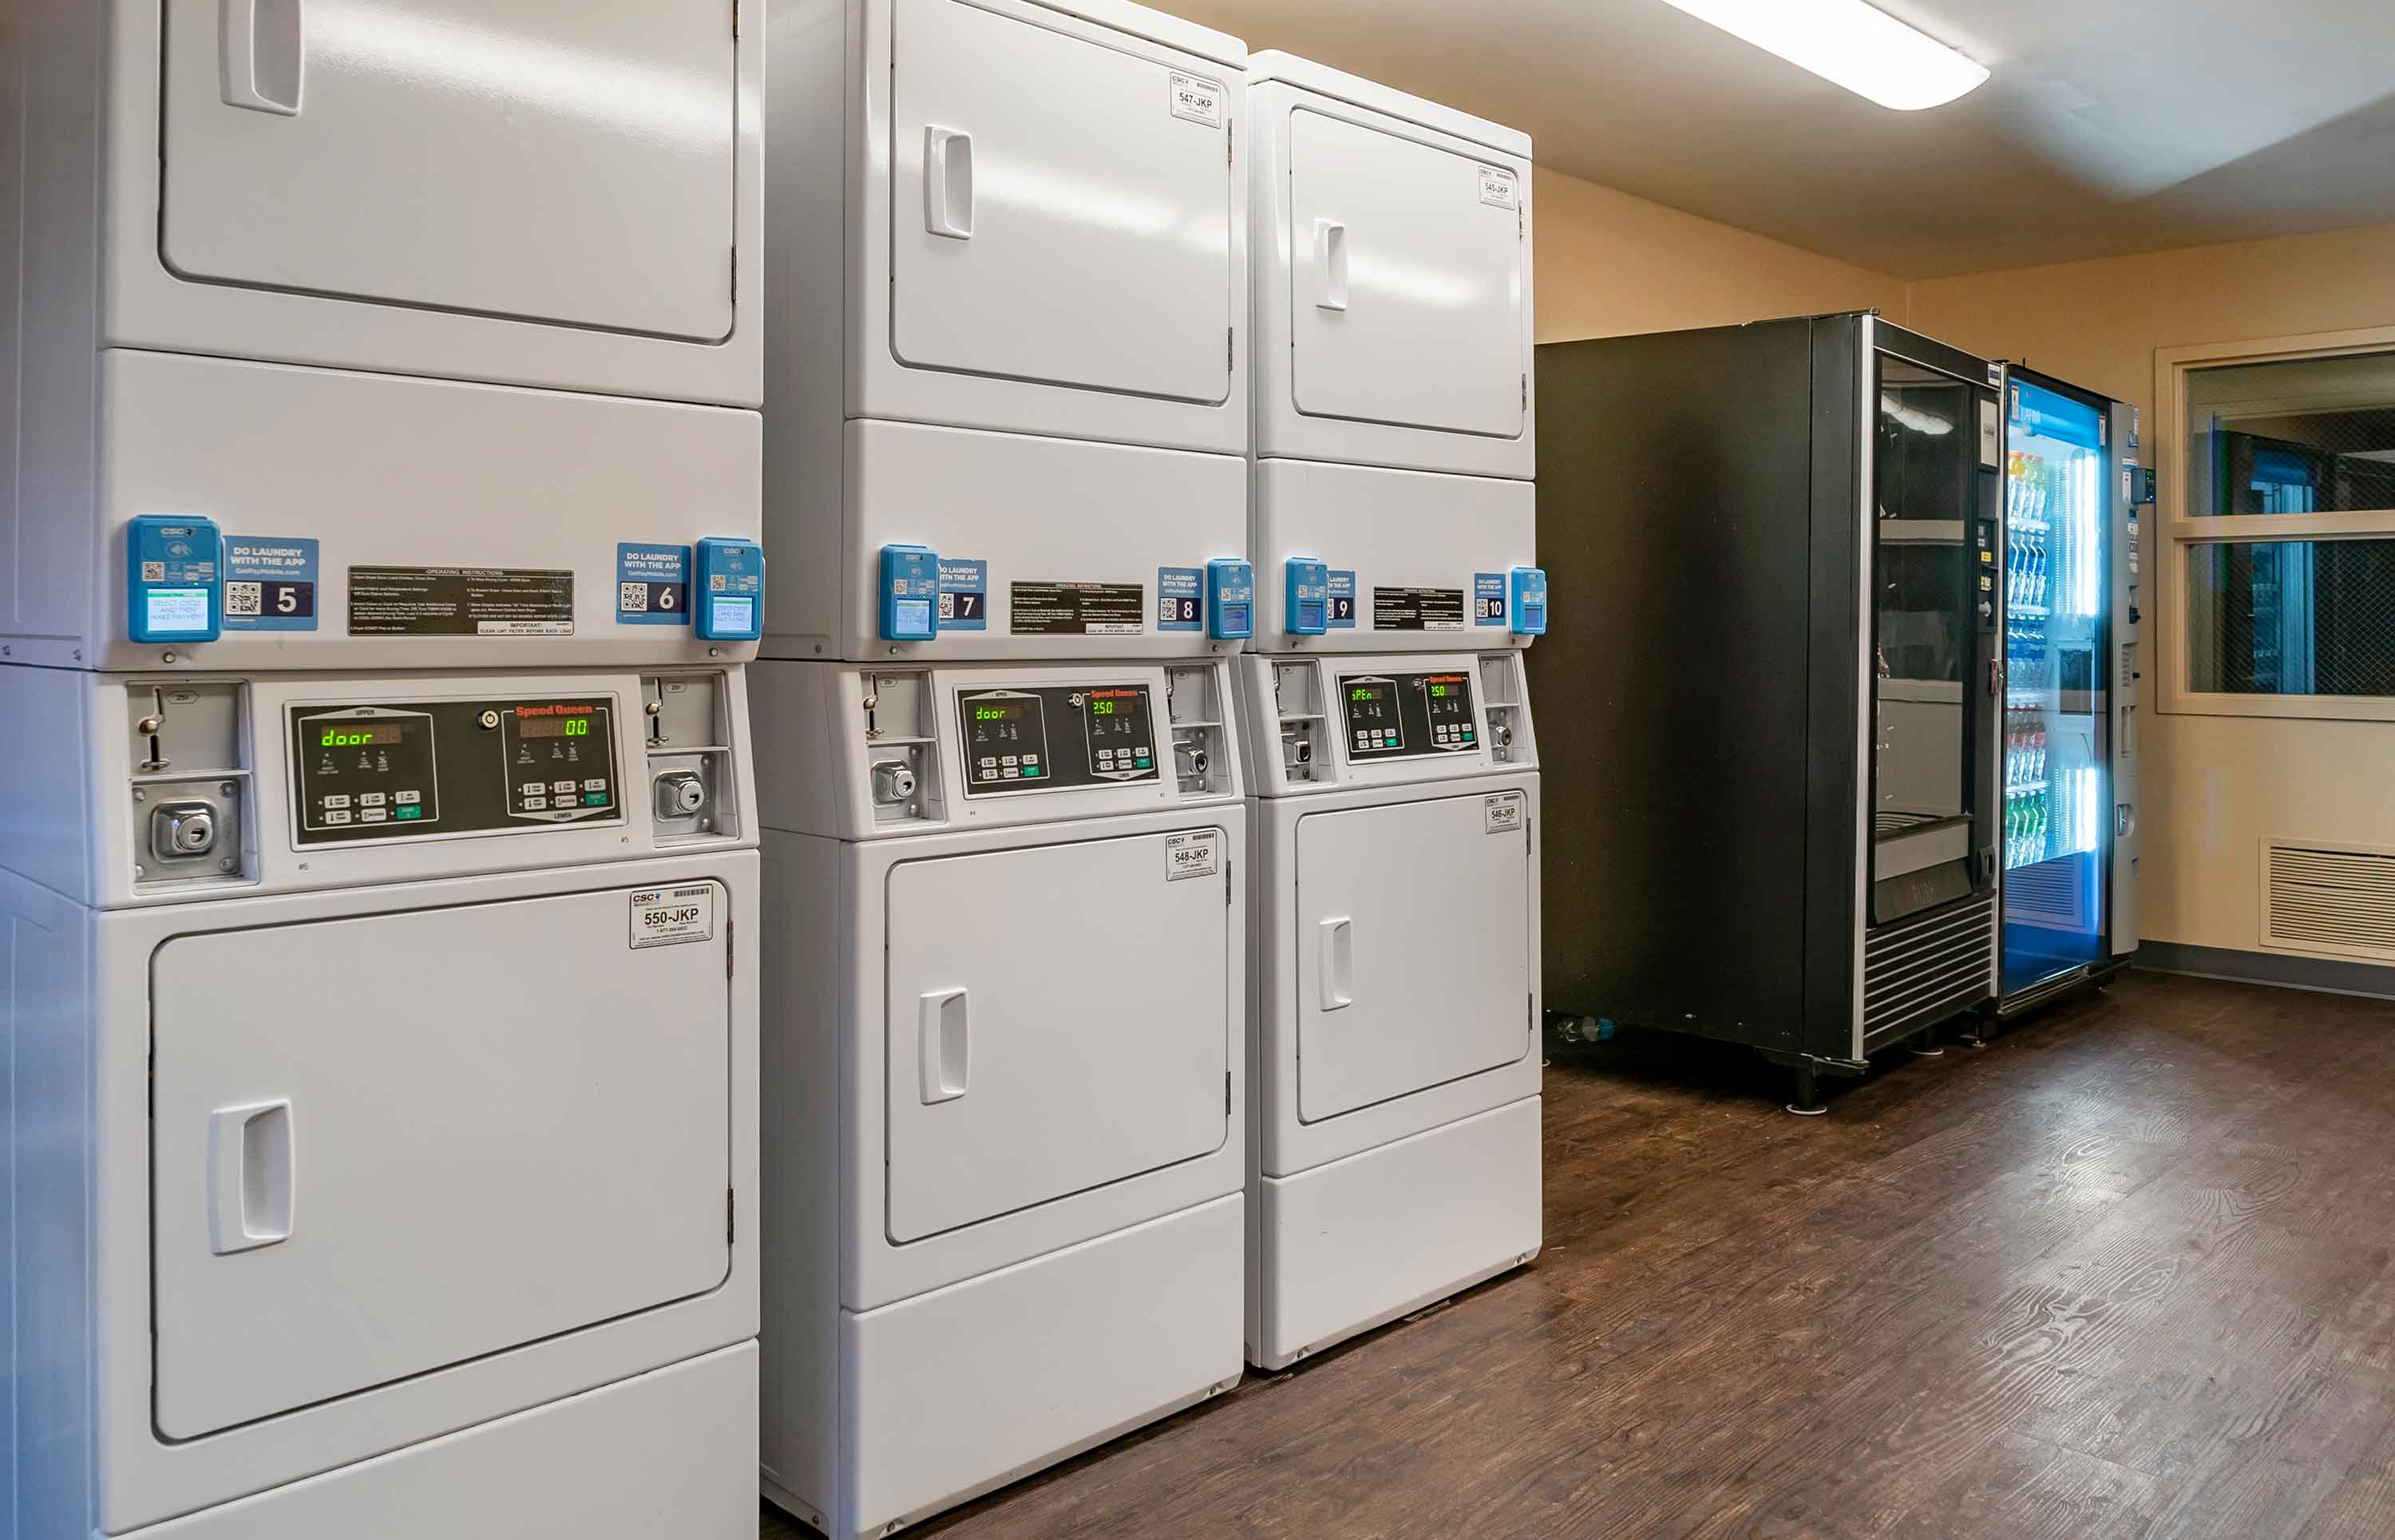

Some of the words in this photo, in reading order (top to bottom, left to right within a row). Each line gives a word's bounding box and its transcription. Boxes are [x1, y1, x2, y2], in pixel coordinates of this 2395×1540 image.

[1179, 92, 1213, 109] 547-JKP
[233, 547, 251, 556] DO
[252, 548, 302, 556] LAUNDRY
[229, 556, 259, 565] WITH
[283, 558, 307, 567] APP
[277, 587, 297, 613] 5
[659, 587, 675, 610] 6
[963, 596, 975, 616] 7
[1183, 600, 1194, 620] 8
[1339, 600, 1348, 617] 9
[1490, 600, 1502, 616] 10
[516, 705, 553, 718] Speed
[555, 704, 592, 715] Queen
[976, 706, 1006, 719] door
[565, 719, 587, 735] 00
[322, 728, 373, 746] door
[1175, 849, 1209, 862] 548-JKP
[633, 893, 655, 902] CSC
[644, 908, 699, 925] 550-JKP
